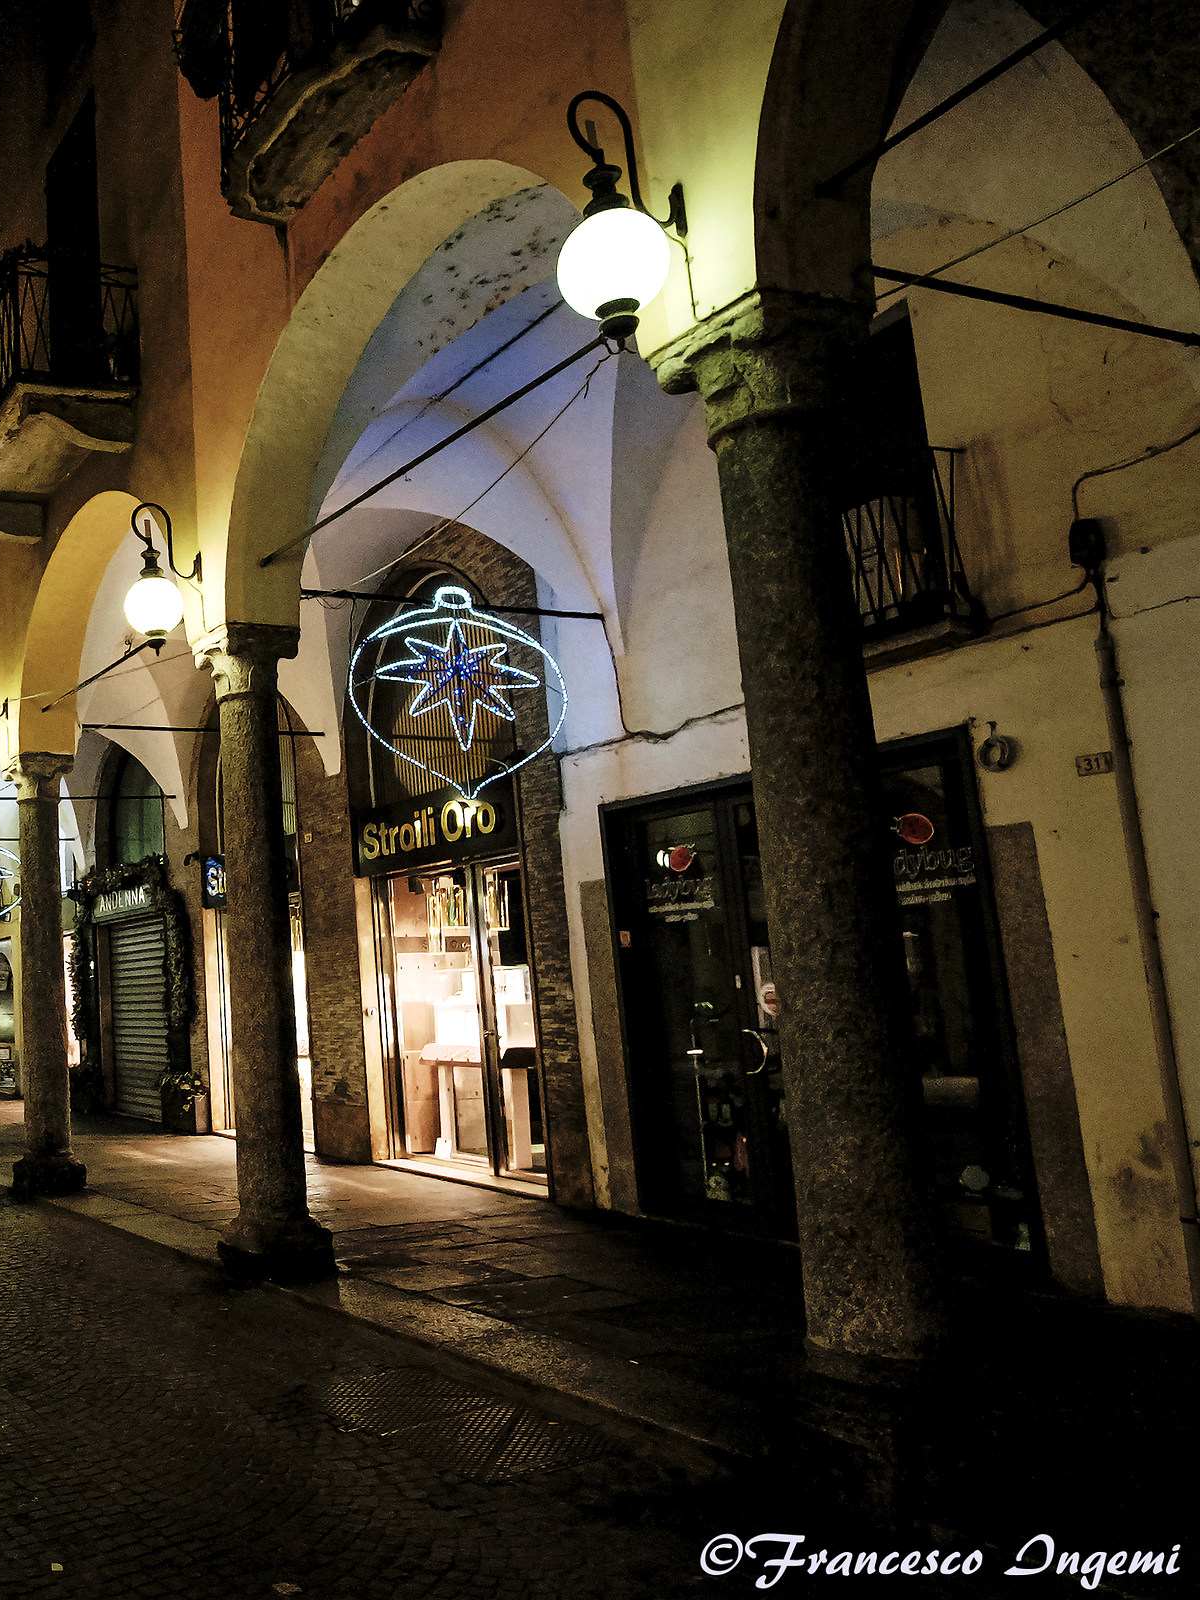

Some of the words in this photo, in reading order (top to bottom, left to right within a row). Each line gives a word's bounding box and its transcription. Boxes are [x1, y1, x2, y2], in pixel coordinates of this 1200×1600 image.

[1083, 757, 1100, 772] 31
[362, 806, 437, 860] Stroili
[440, 799, 497, 842] Oro
[892, 846, 975, 880] dybug
[99, 886, 146, 912] ANDENNA
